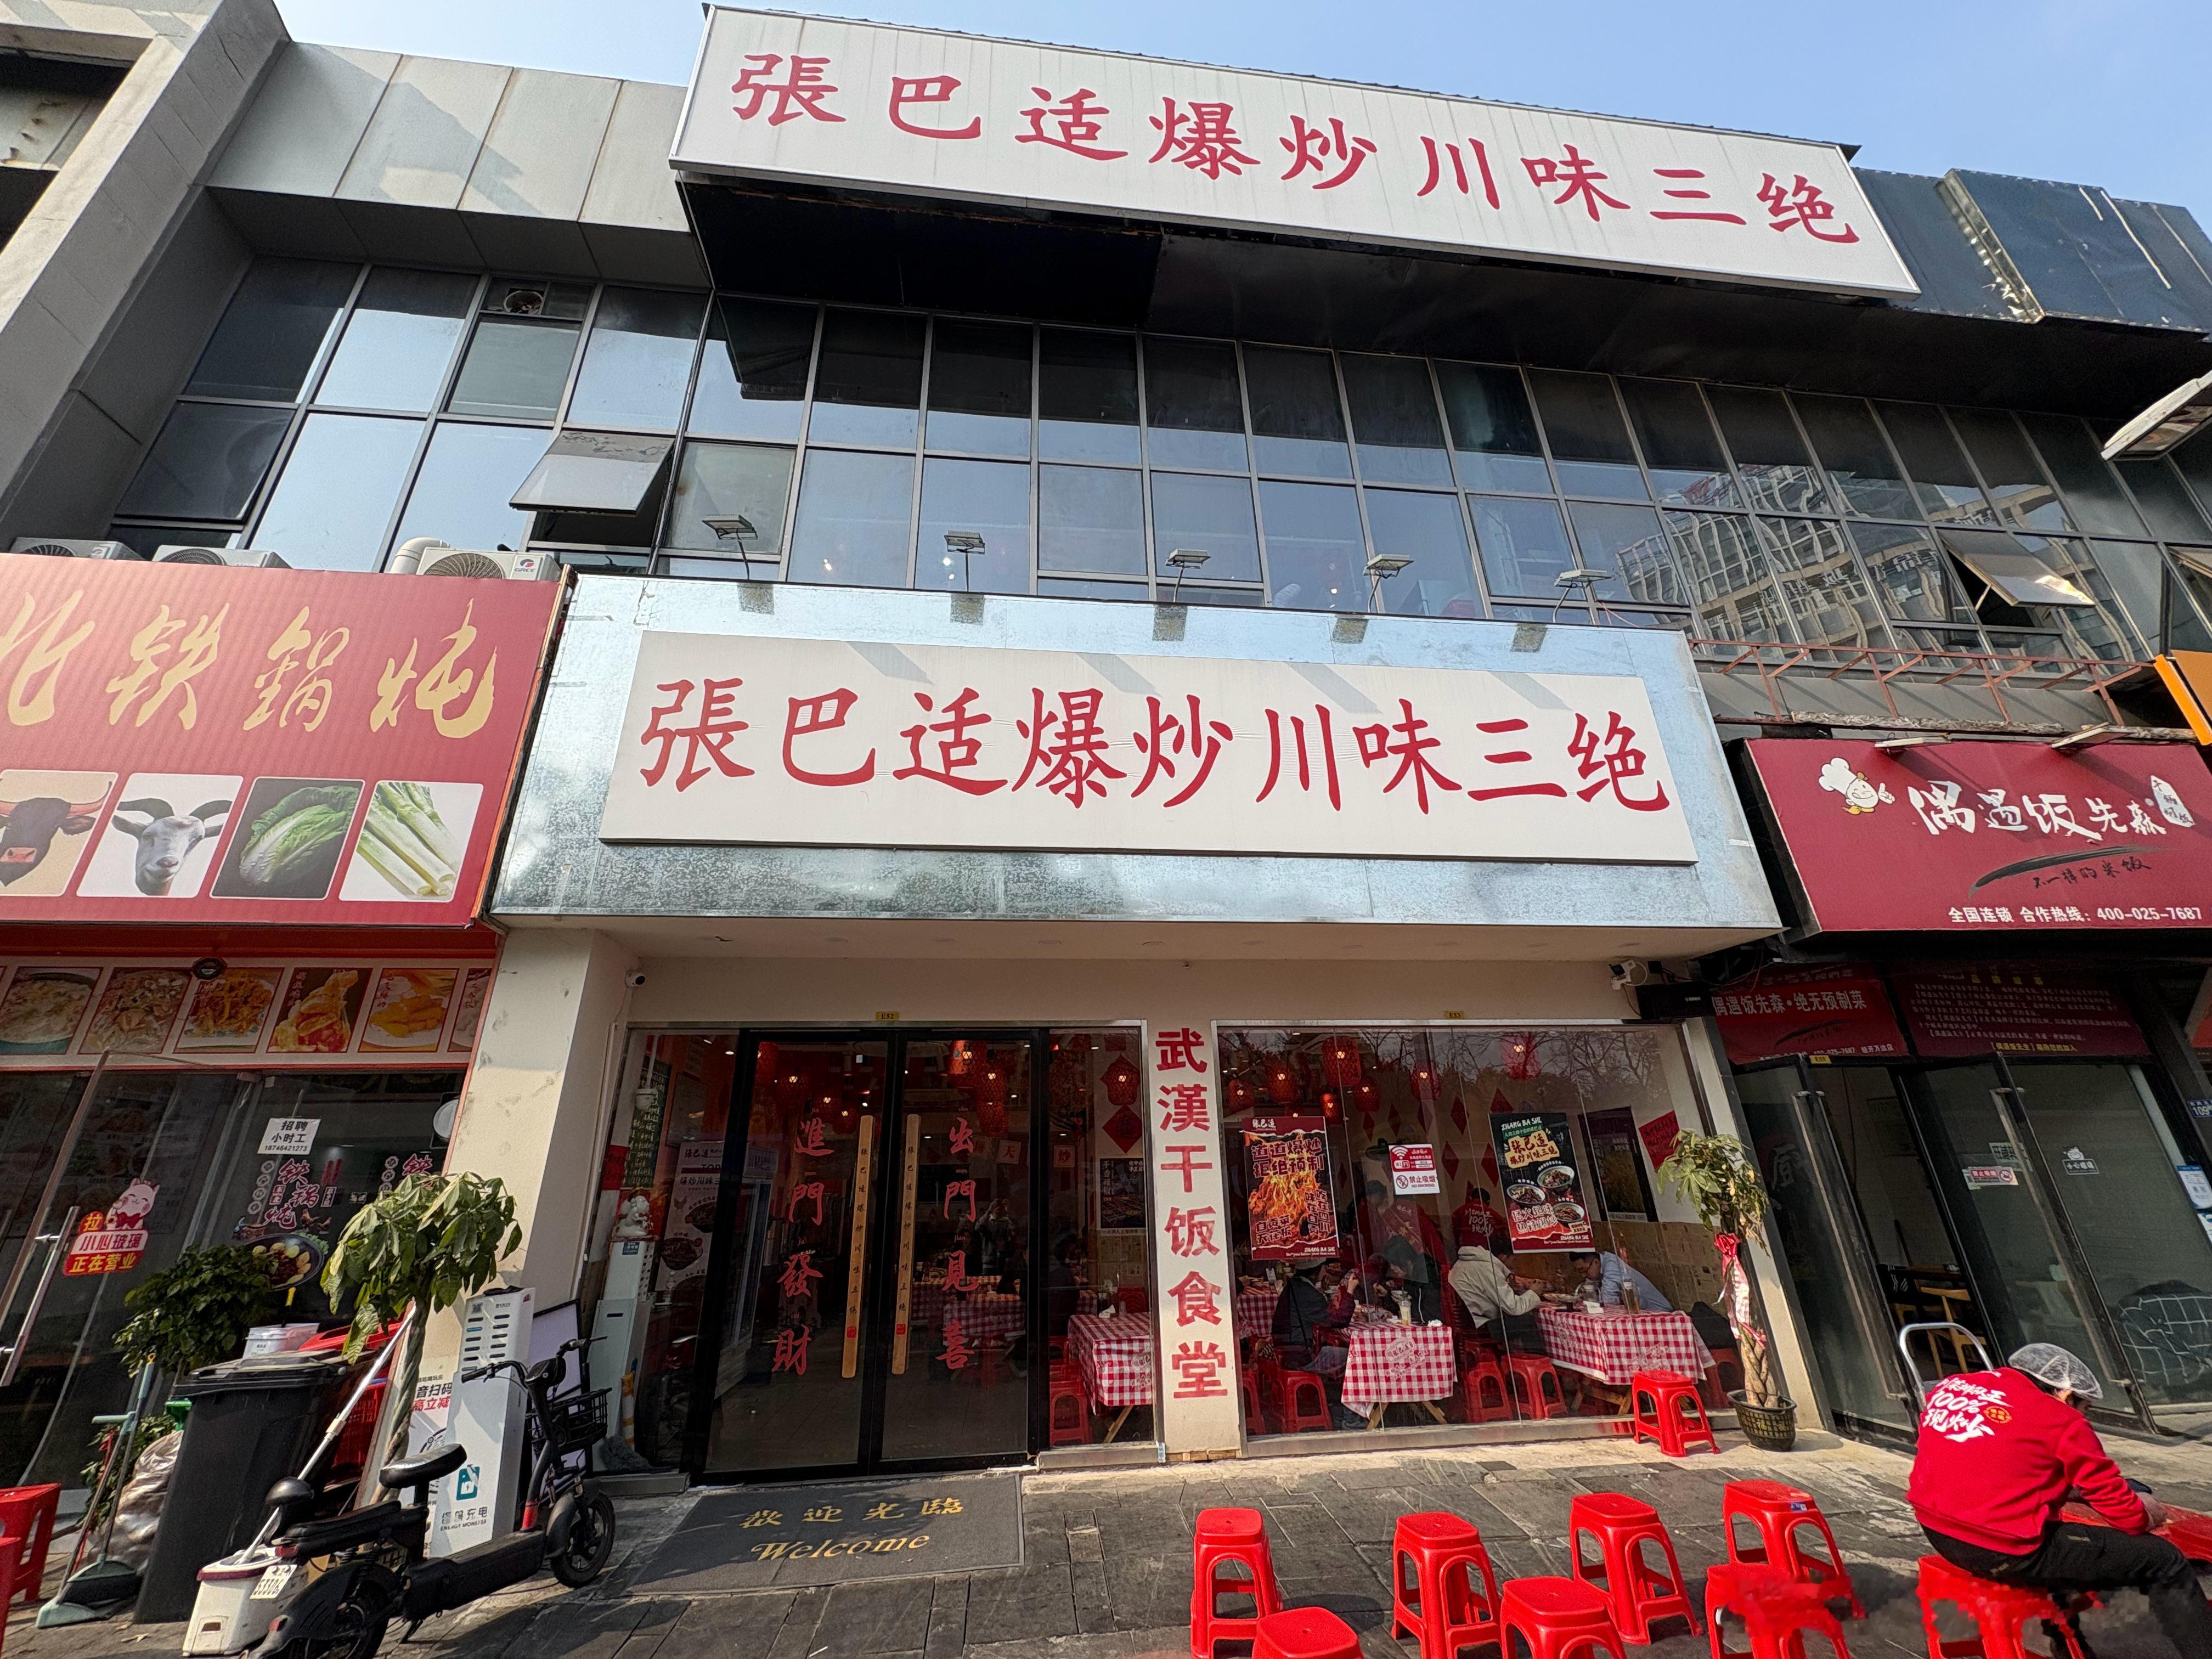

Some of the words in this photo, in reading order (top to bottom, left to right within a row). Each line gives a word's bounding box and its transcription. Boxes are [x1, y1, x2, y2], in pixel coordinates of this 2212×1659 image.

[733, 55, 1859, 243] 張巴适爆炒川味三绝
[641, 678, 1670, 815] 張巴适爆炒川味三绝
[1948, 907, 2013, 923] 全国连锁
[2097, 907, 2202, 921] 400-025-7687
[280, 1121, 308, 1132] 招聘
[271, 1133, 306, 1143] 小时工
[1251, 1137, 1323, 1161] 道道爆炒
[1511, 1133, 1548, 1154] 张巴适
[1253, 1154, 1325, 1178] 拒绝预制
[1409, 1175, 1436, 1183] 禁止吸烟
[83, 1212, 103, 1231] 拉
[1155, 1028, 1228, 1399] 武漢干饭食堂
[79, 1233, 143, 1251] 小心玻璃
[772, 1118, 834, 1375] 進門發財
[936, 1117, 979, 1369] 出門見喜
[69, 1252, 137, 1273] 正在营业
[751, 1535, 930, 1561] Welcome
